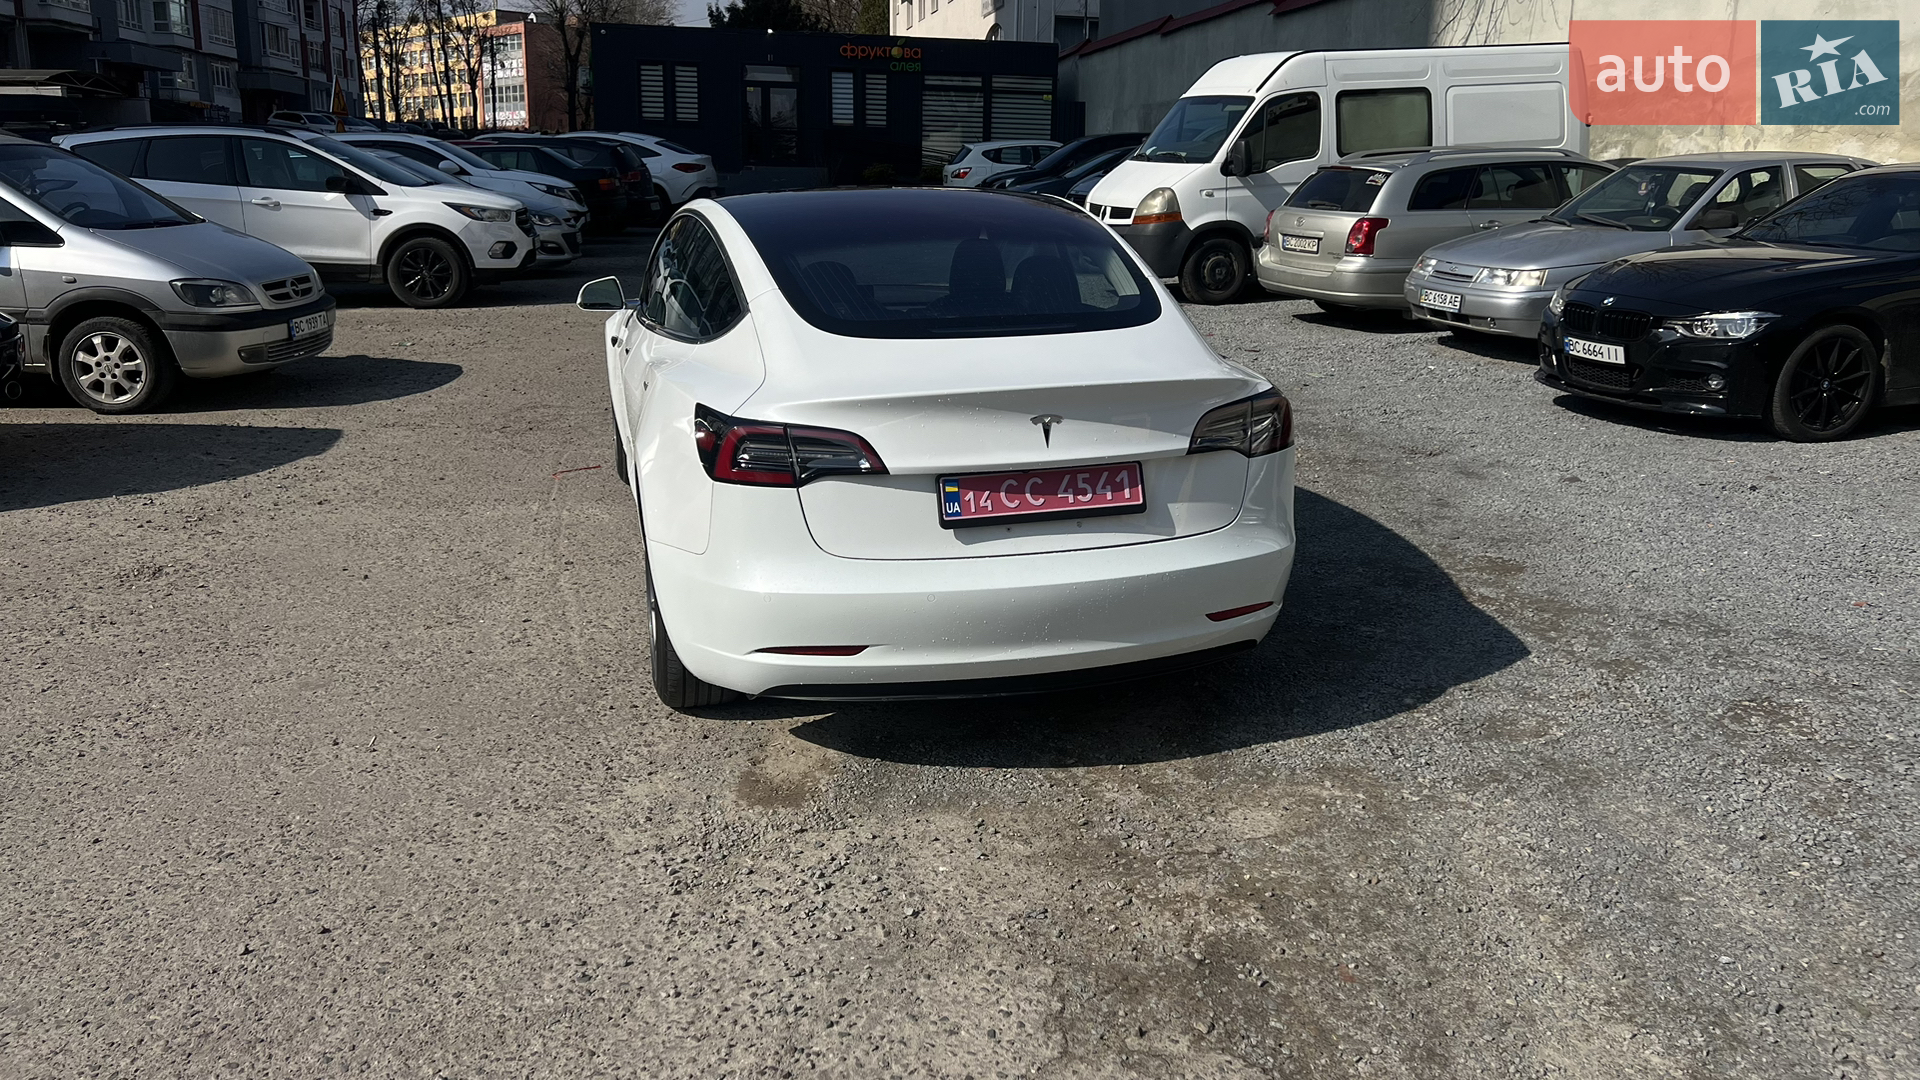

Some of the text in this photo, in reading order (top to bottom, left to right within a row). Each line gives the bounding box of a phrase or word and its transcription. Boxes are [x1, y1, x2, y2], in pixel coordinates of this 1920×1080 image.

[889, 61, 922, 72] алея
[1448, 295, 1460, 307] AE
[295, 320, 305, 334] BC
[1568, 339, 1581, 354] BC
[1582, 342, 1604, 359] 6664
[964, 469, 1131, 513] 14 CC 4541
[945, 501, 961, 514] UA
